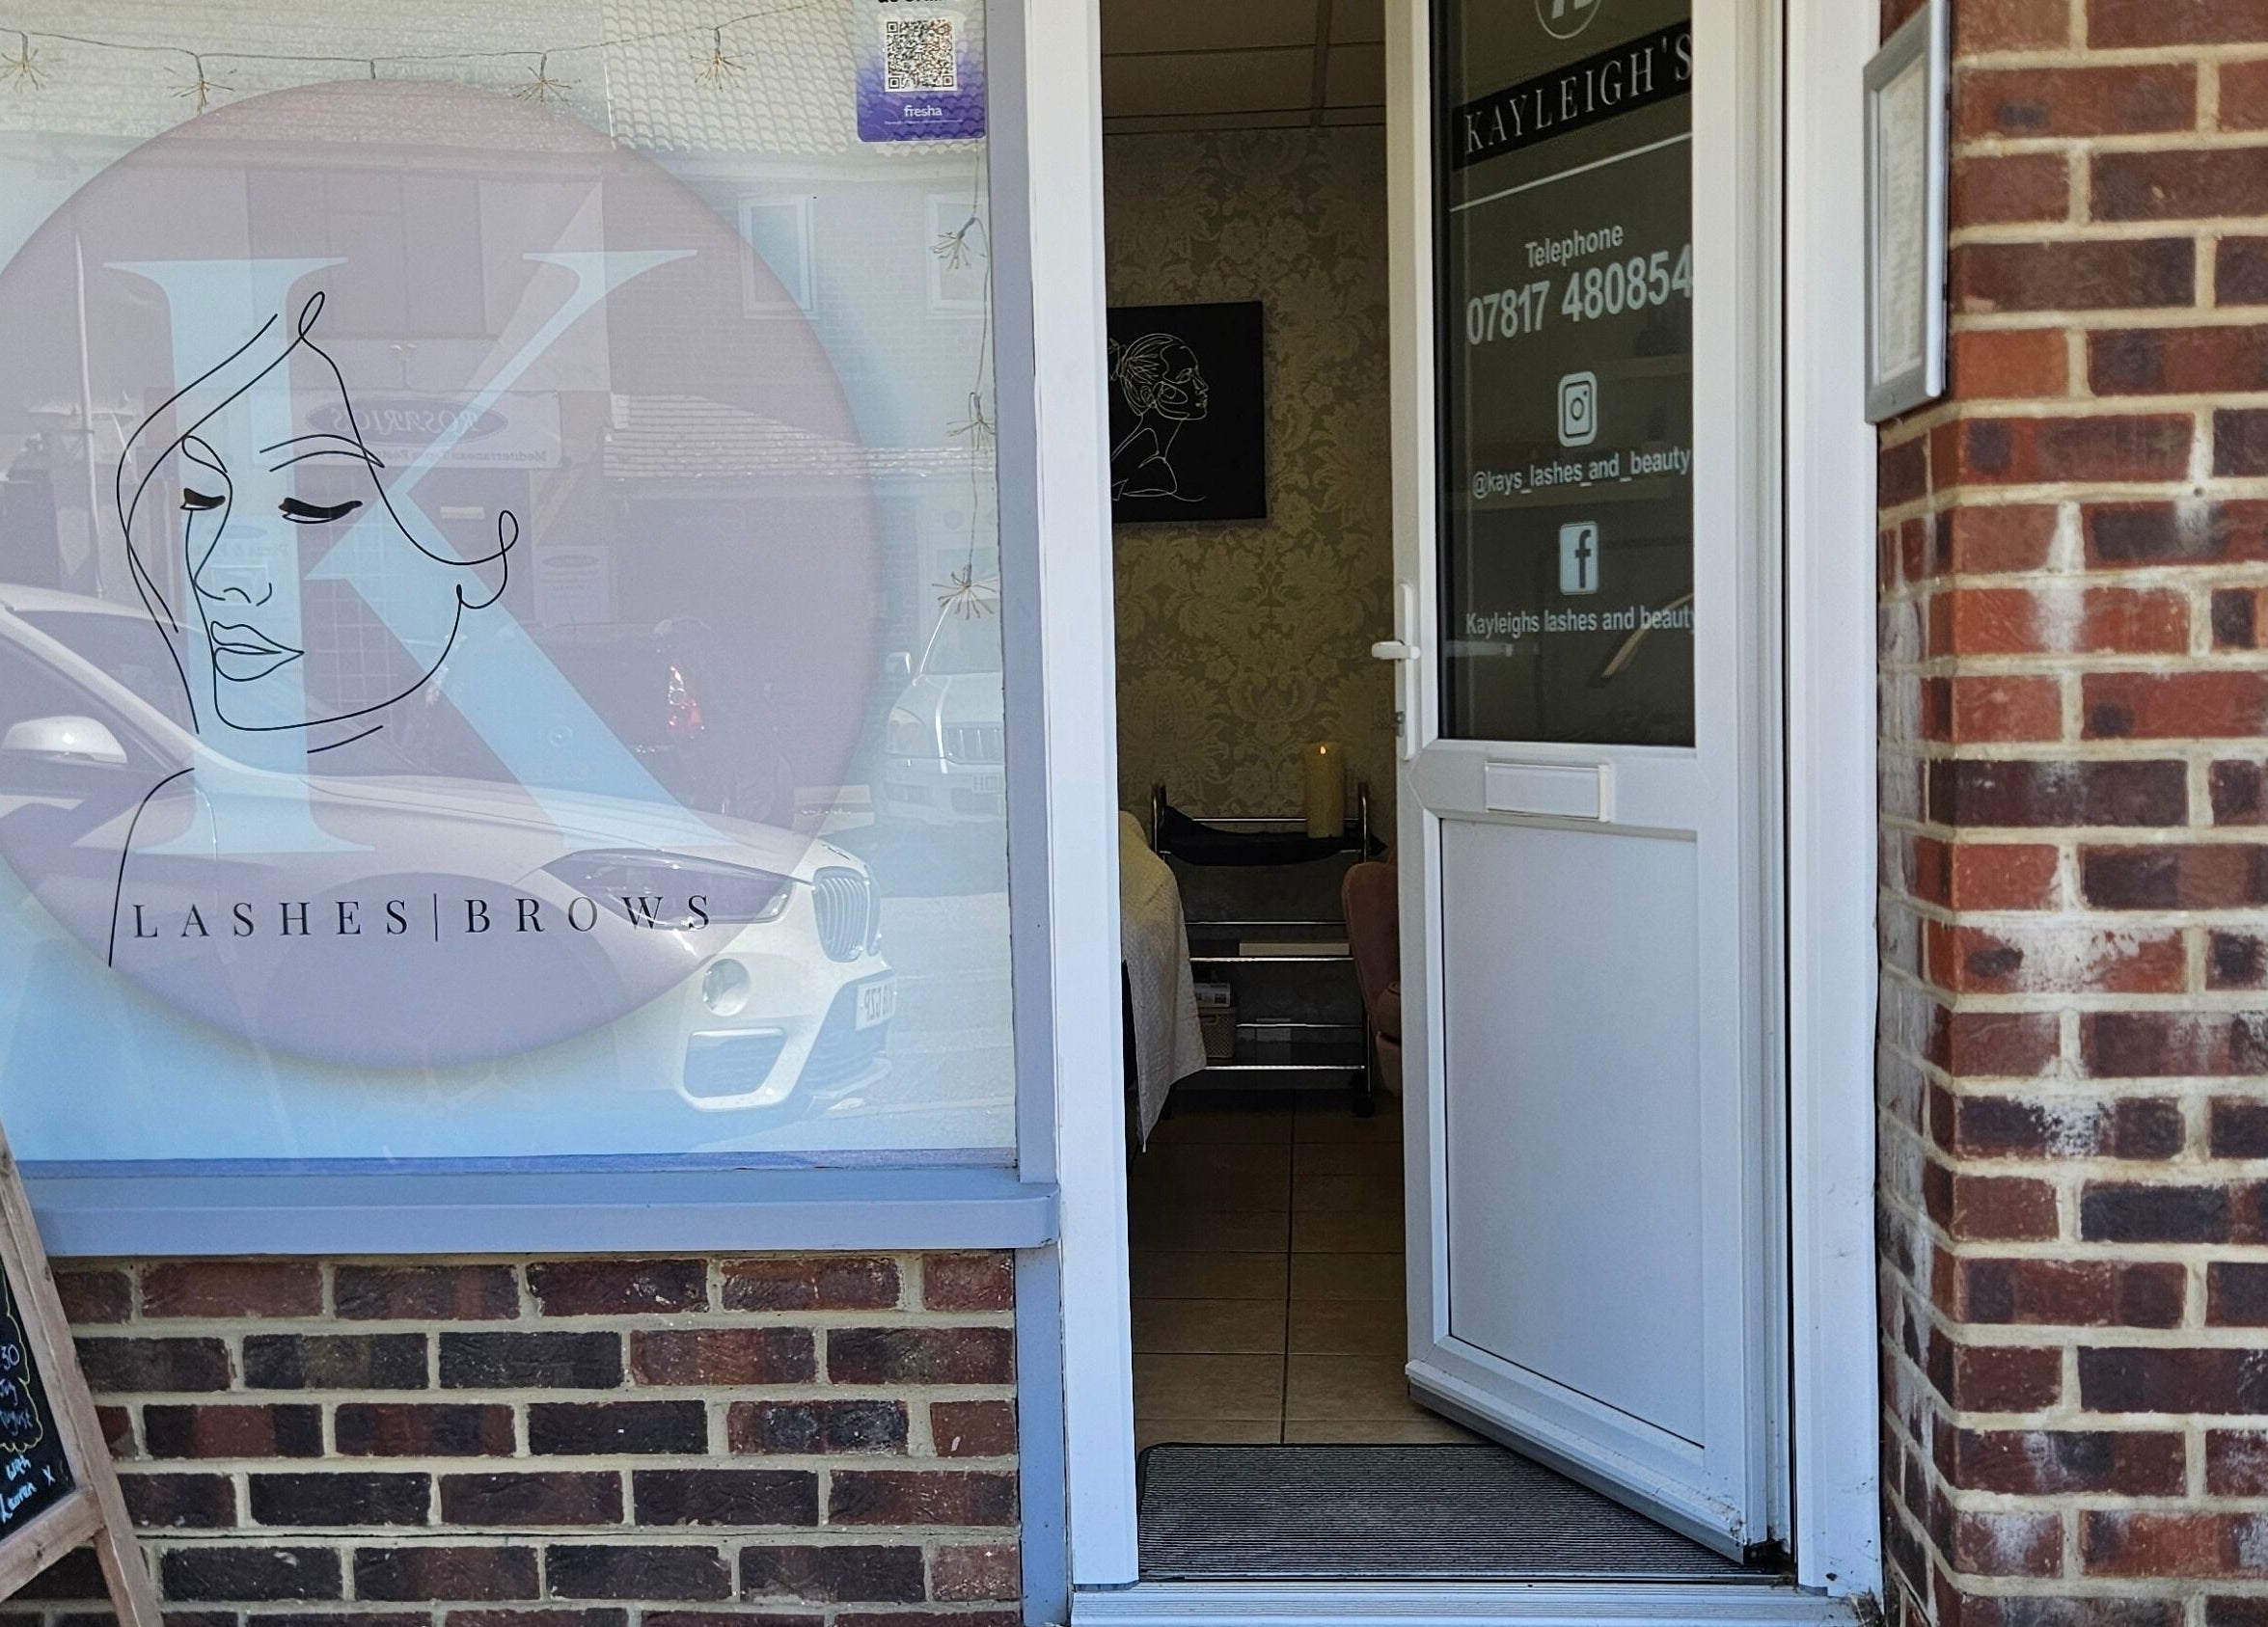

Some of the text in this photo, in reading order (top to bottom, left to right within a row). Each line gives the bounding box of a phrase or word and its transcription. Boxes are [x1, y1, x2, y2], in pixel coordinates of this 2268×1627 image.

[903, 104, 943, 118] fresha
[1464, 33, 1692, 153] KAYLEIGH'S
[1525, 225, 1624, 268] Telephone
[1466, 243, 1693, 345] 07817 480854
[1465, 610, 1540, 639] Kayleighs
[1544, 609, 1598, 633] lashes
[1602, 606, 1634, 631] and
[132, 894, 710, 938] LASHES BROWS
